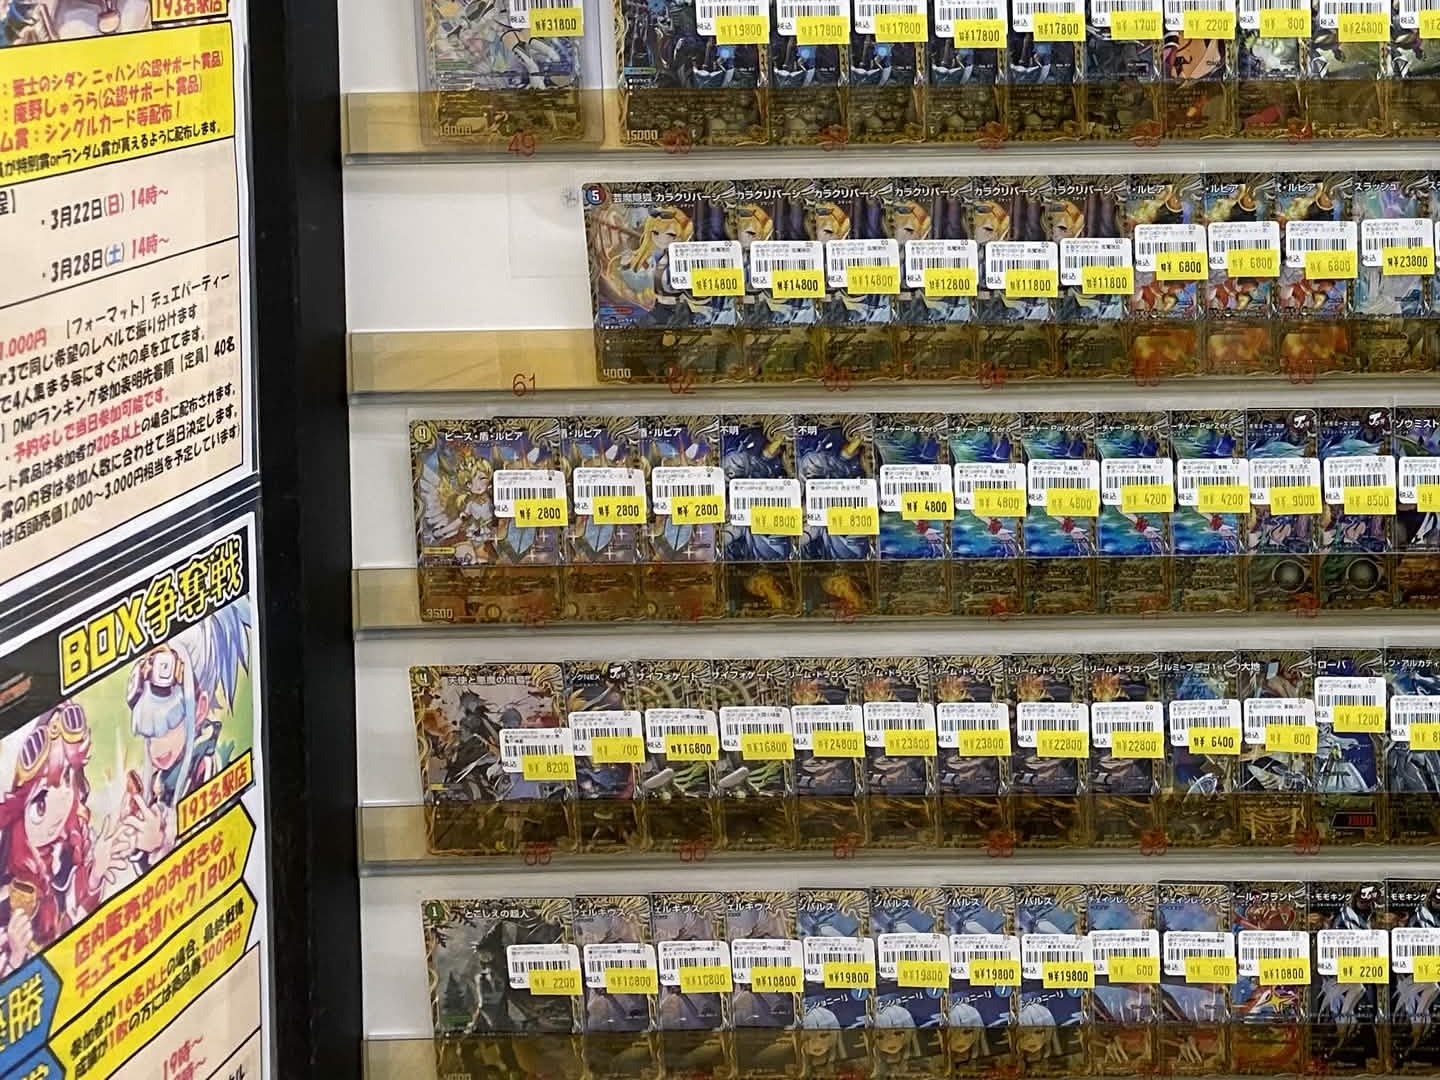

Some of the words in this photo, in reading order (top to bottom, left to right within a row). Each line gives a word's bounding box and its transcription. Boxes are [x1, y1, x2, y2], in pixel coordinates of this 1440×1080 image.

[591, 190, 600, 202] 5
[512, 375, 537, 395] 61
[60, 535, 242, 694] BOX争奪戦
[181, 759, 249, 825] 193名駅店
[0, 973, 44, 1048] 勝
